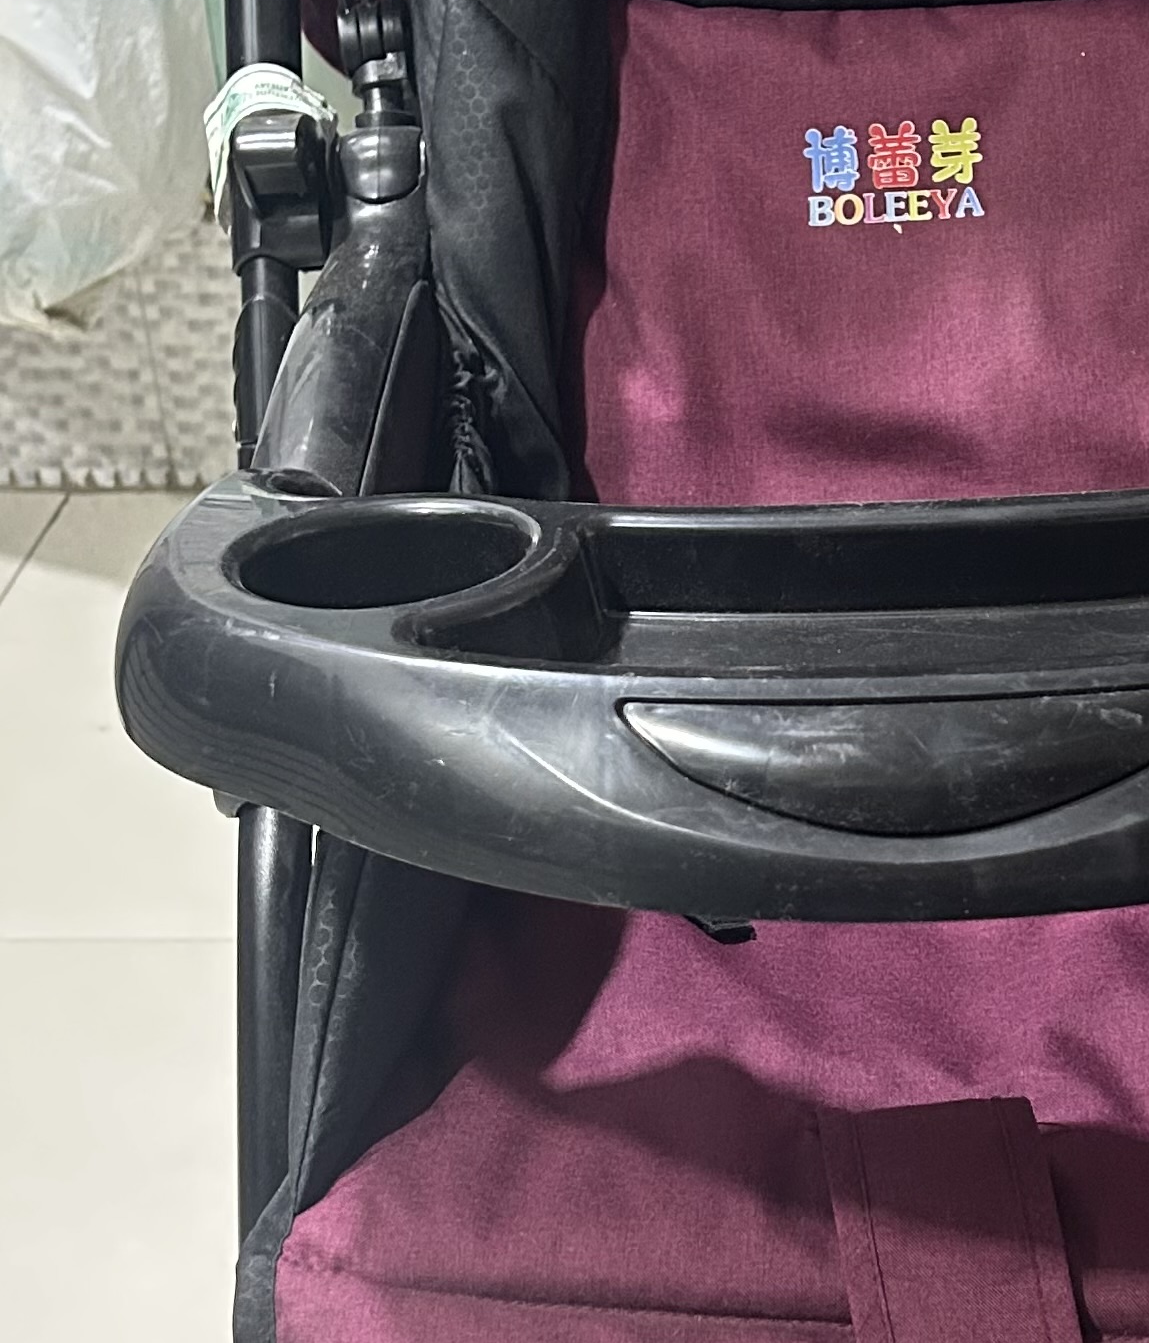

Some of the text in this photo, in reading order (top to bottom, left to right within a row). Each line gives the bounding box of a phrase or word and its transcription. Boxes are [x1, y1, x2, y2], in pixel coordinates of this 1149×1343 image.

[803, 117, 983, 192] 博蕾芽
[807, 186, 985, 226] BOLEEYA
